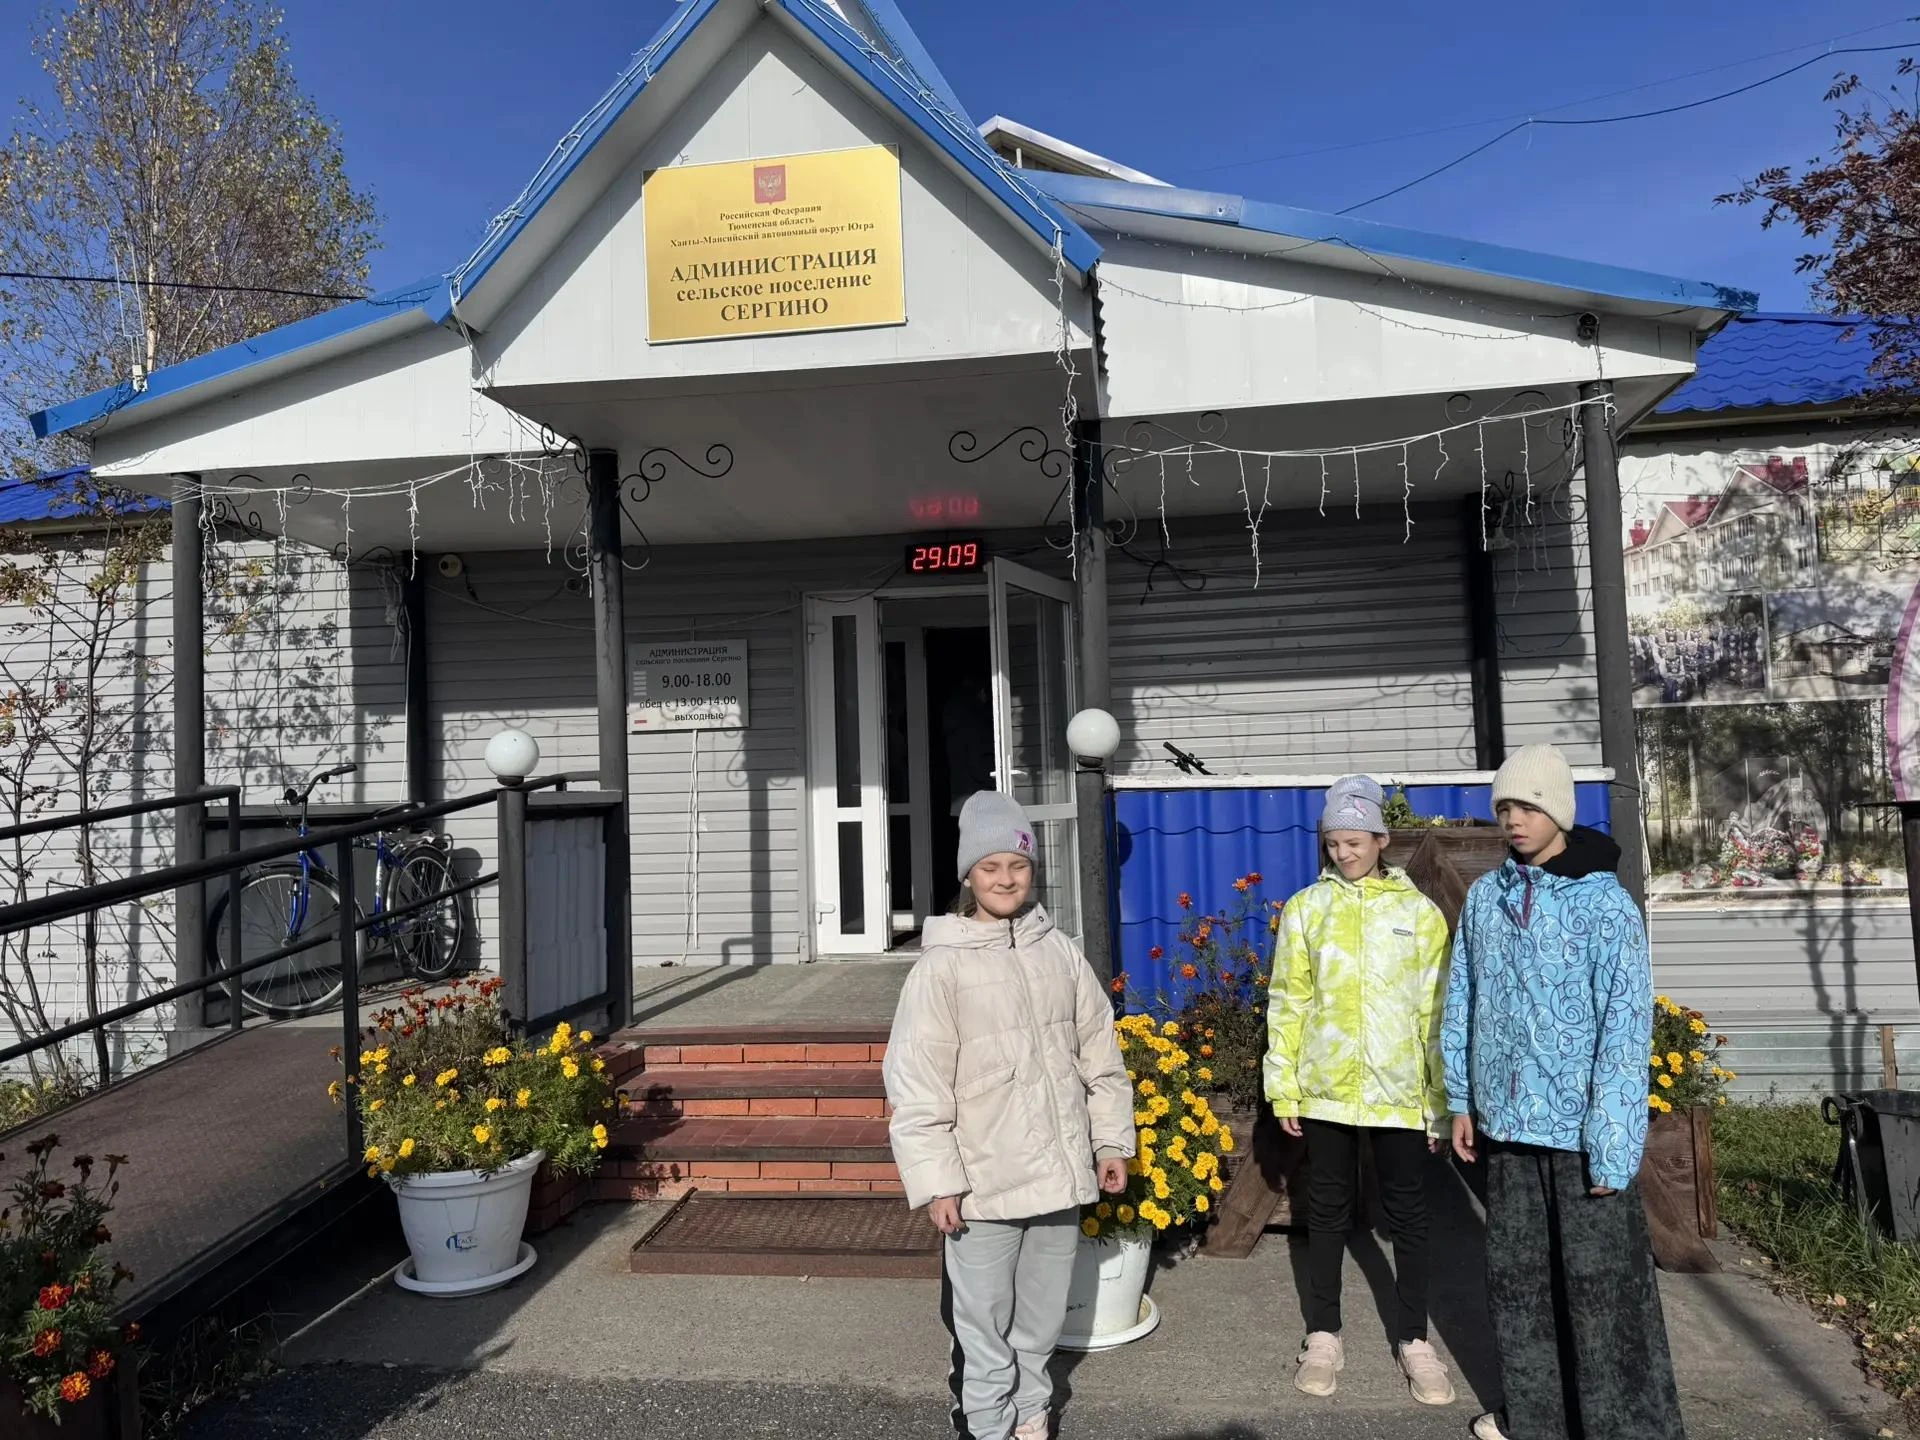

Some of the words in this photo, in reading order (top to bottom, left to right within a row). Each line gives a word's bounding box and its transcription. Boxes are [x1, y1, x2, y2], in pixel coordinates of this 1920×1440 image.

[728, 219, 777, 232] Тюменская
[819, 224, 846, 236] округ
[848, 221, 875, 234] Югра
[670, 248, 877, 282] АДМИНИСТРАЦИЯ
[676, 283, 764, 302] сельское
[769, 273, 872, 295] поселение
[720, 297, 829, 322] СЕРГИНО
[912, 543, 977, 570] 29.09
[649, 646, 728, 658] АДМИНИСТРАЦИЯ
[662, 672, 731, 688] 9.00-18.00
[640, 698, 662, 709] обед
[675, 696, 737, 707] 13.00-14.00
[674, 712, 724, 721] выходные
